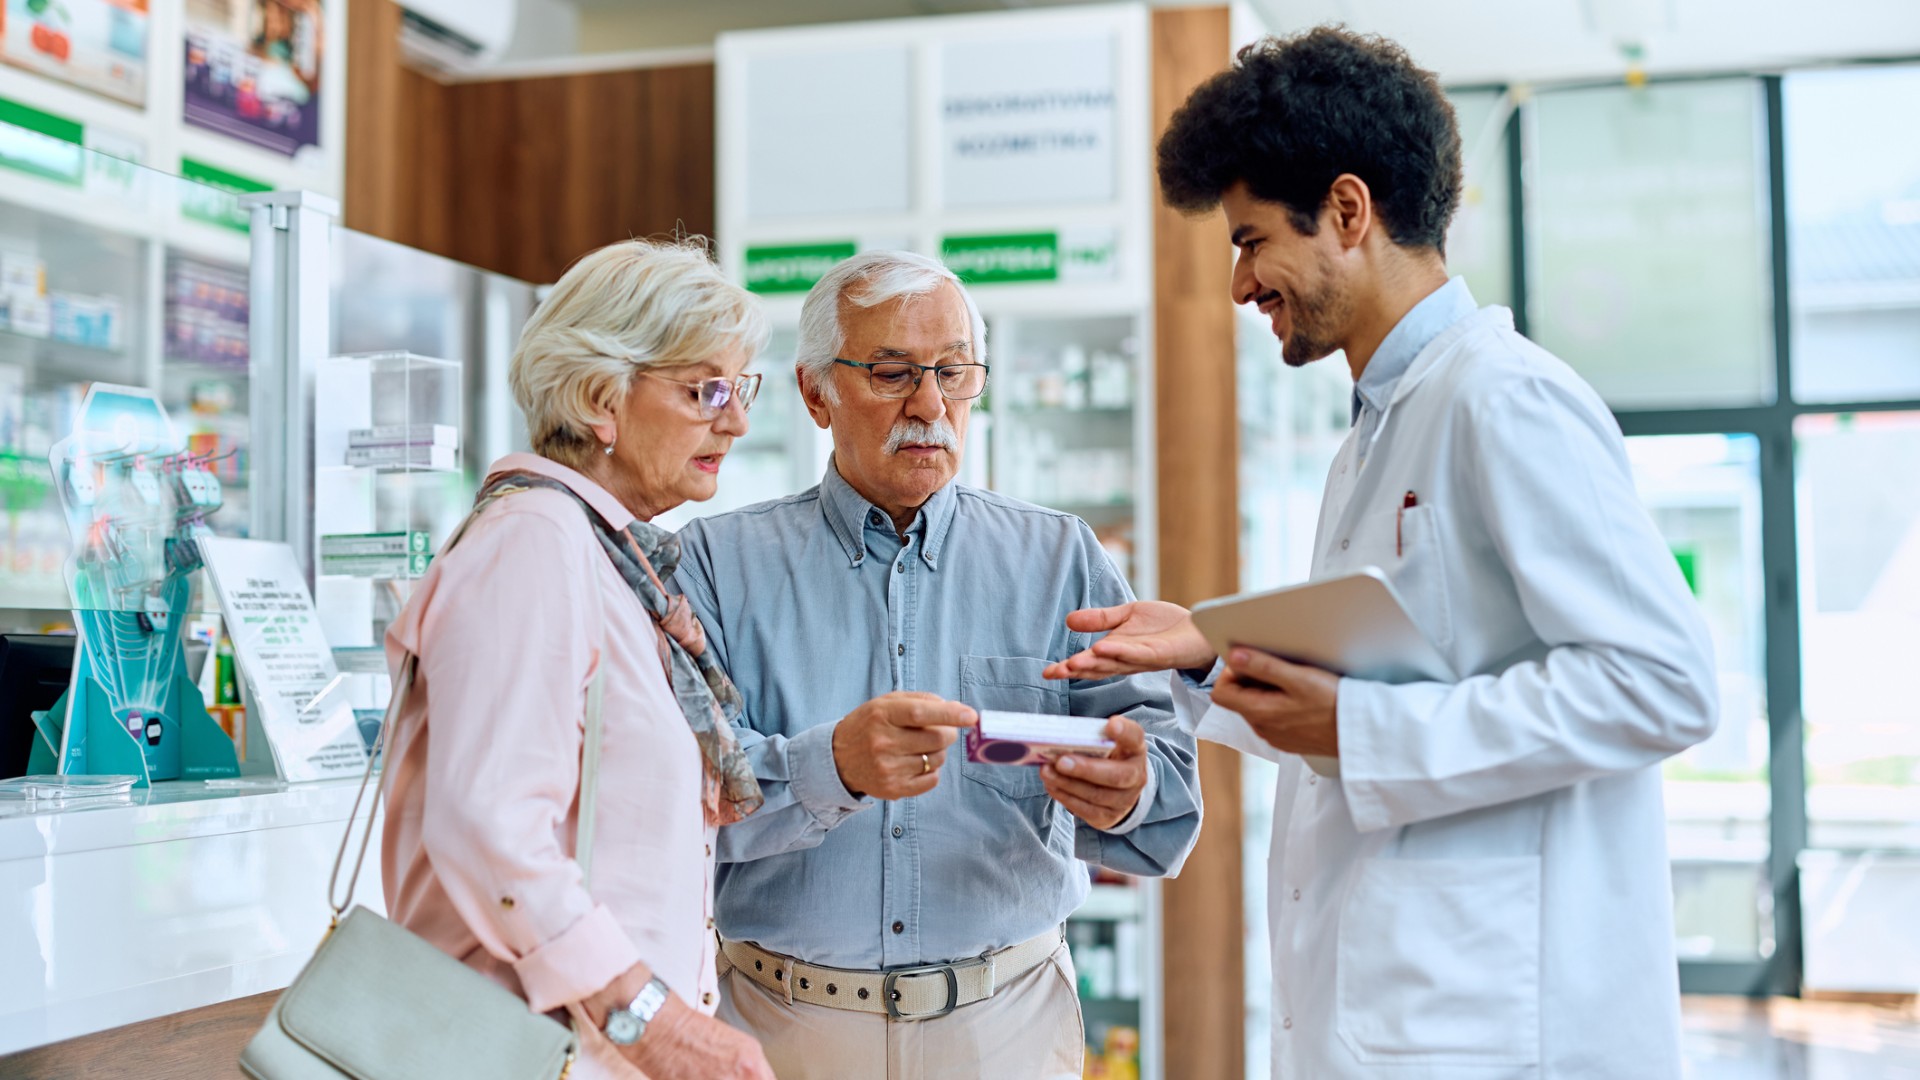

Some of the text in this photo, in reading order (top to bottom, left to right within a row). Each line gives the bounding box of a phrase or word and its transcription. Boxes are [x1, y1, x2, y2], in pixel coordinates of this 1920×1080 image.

[943, 90, 1114, 116] DEKORATIVNA
[956, 132, 1098, 155] KOZMETIKA
[747, 255, 846, 282] APOTEK
[948, 245, 1054, 273] APOTEKA
